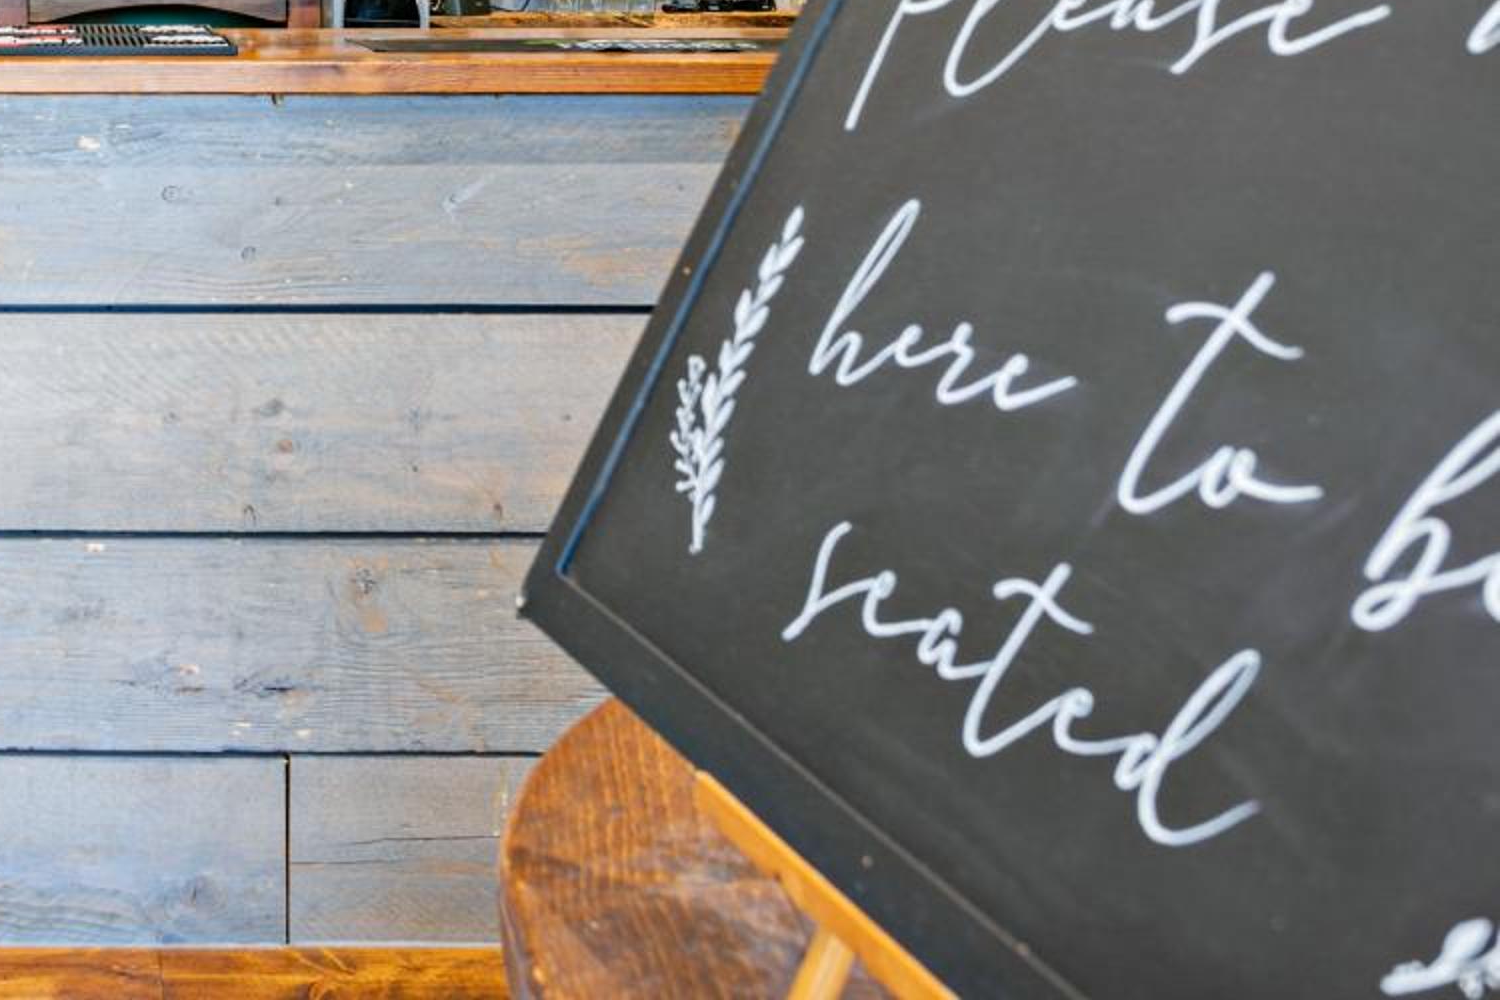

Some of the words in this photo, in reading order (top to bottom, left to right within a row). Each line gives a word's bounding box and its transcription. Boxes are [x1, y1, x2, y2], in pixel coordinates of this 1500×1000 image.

[808, 198, 1078, 412] here
[1118, 271, 1324, 514] to
[1350, 408, 1500, 632] b
[781, 520, 1261, 847] seated
